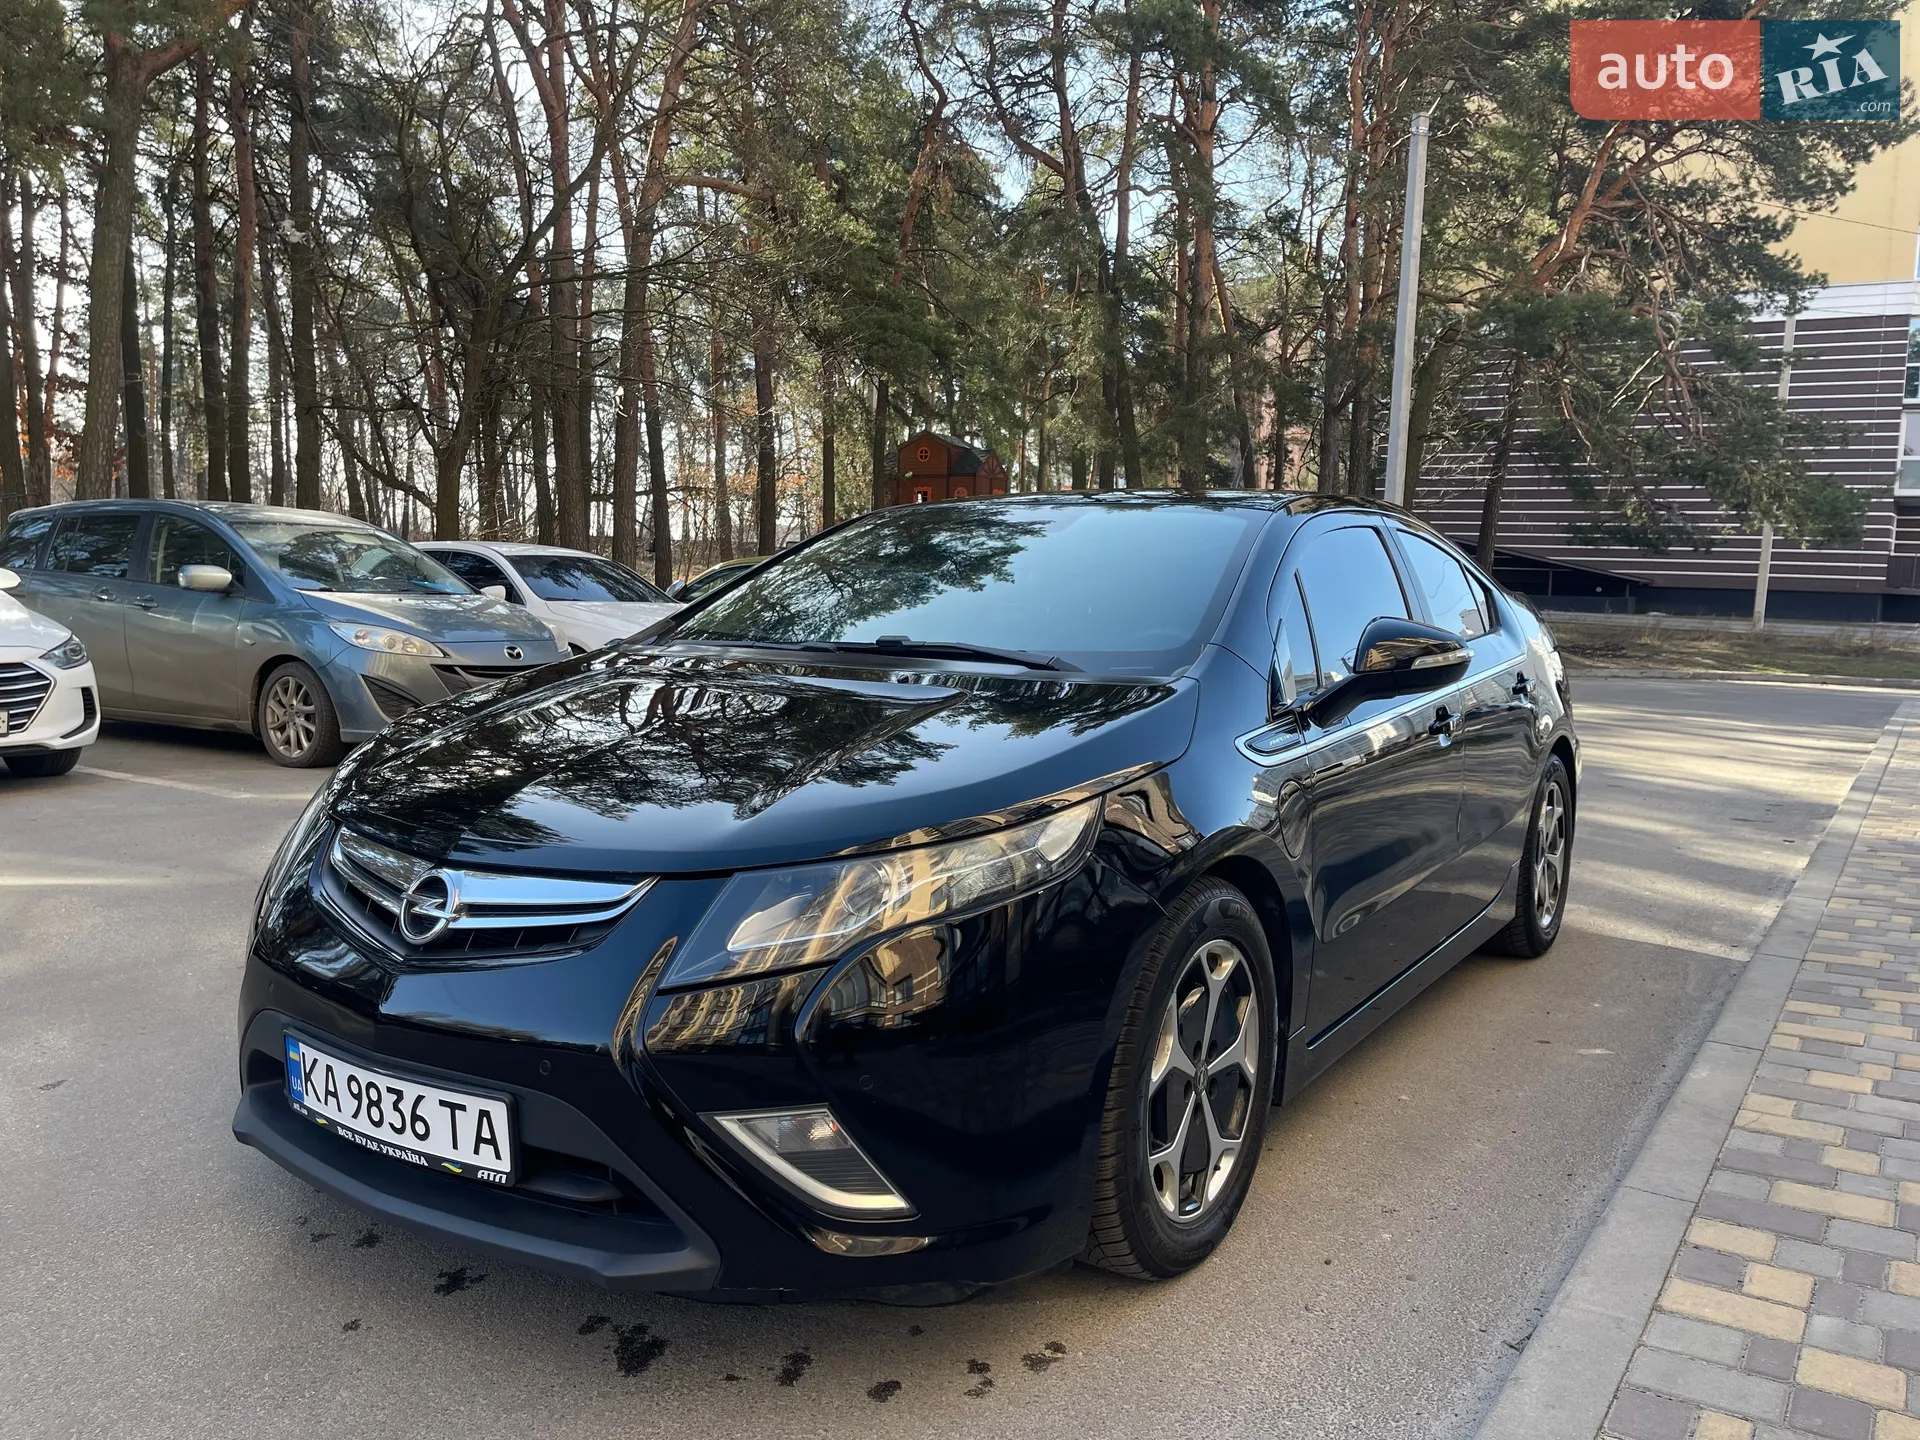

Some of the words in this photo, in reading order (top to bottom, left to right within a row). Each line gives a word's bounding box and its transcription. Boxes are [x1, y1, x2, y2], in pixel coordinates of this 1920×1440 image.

[291, 1076, 303, 1093] UA
[302, 1051, 342, 1113] KA
[346, 1074, 431, 1141] 9836
[438, 1099, 502, 1161] TA
[337, 1125, 354, 1140] ВСЕ
[354, 1134, 380, 1152] БУДЕ
[380, 1144, 429, 1166] УКРАЇНА
